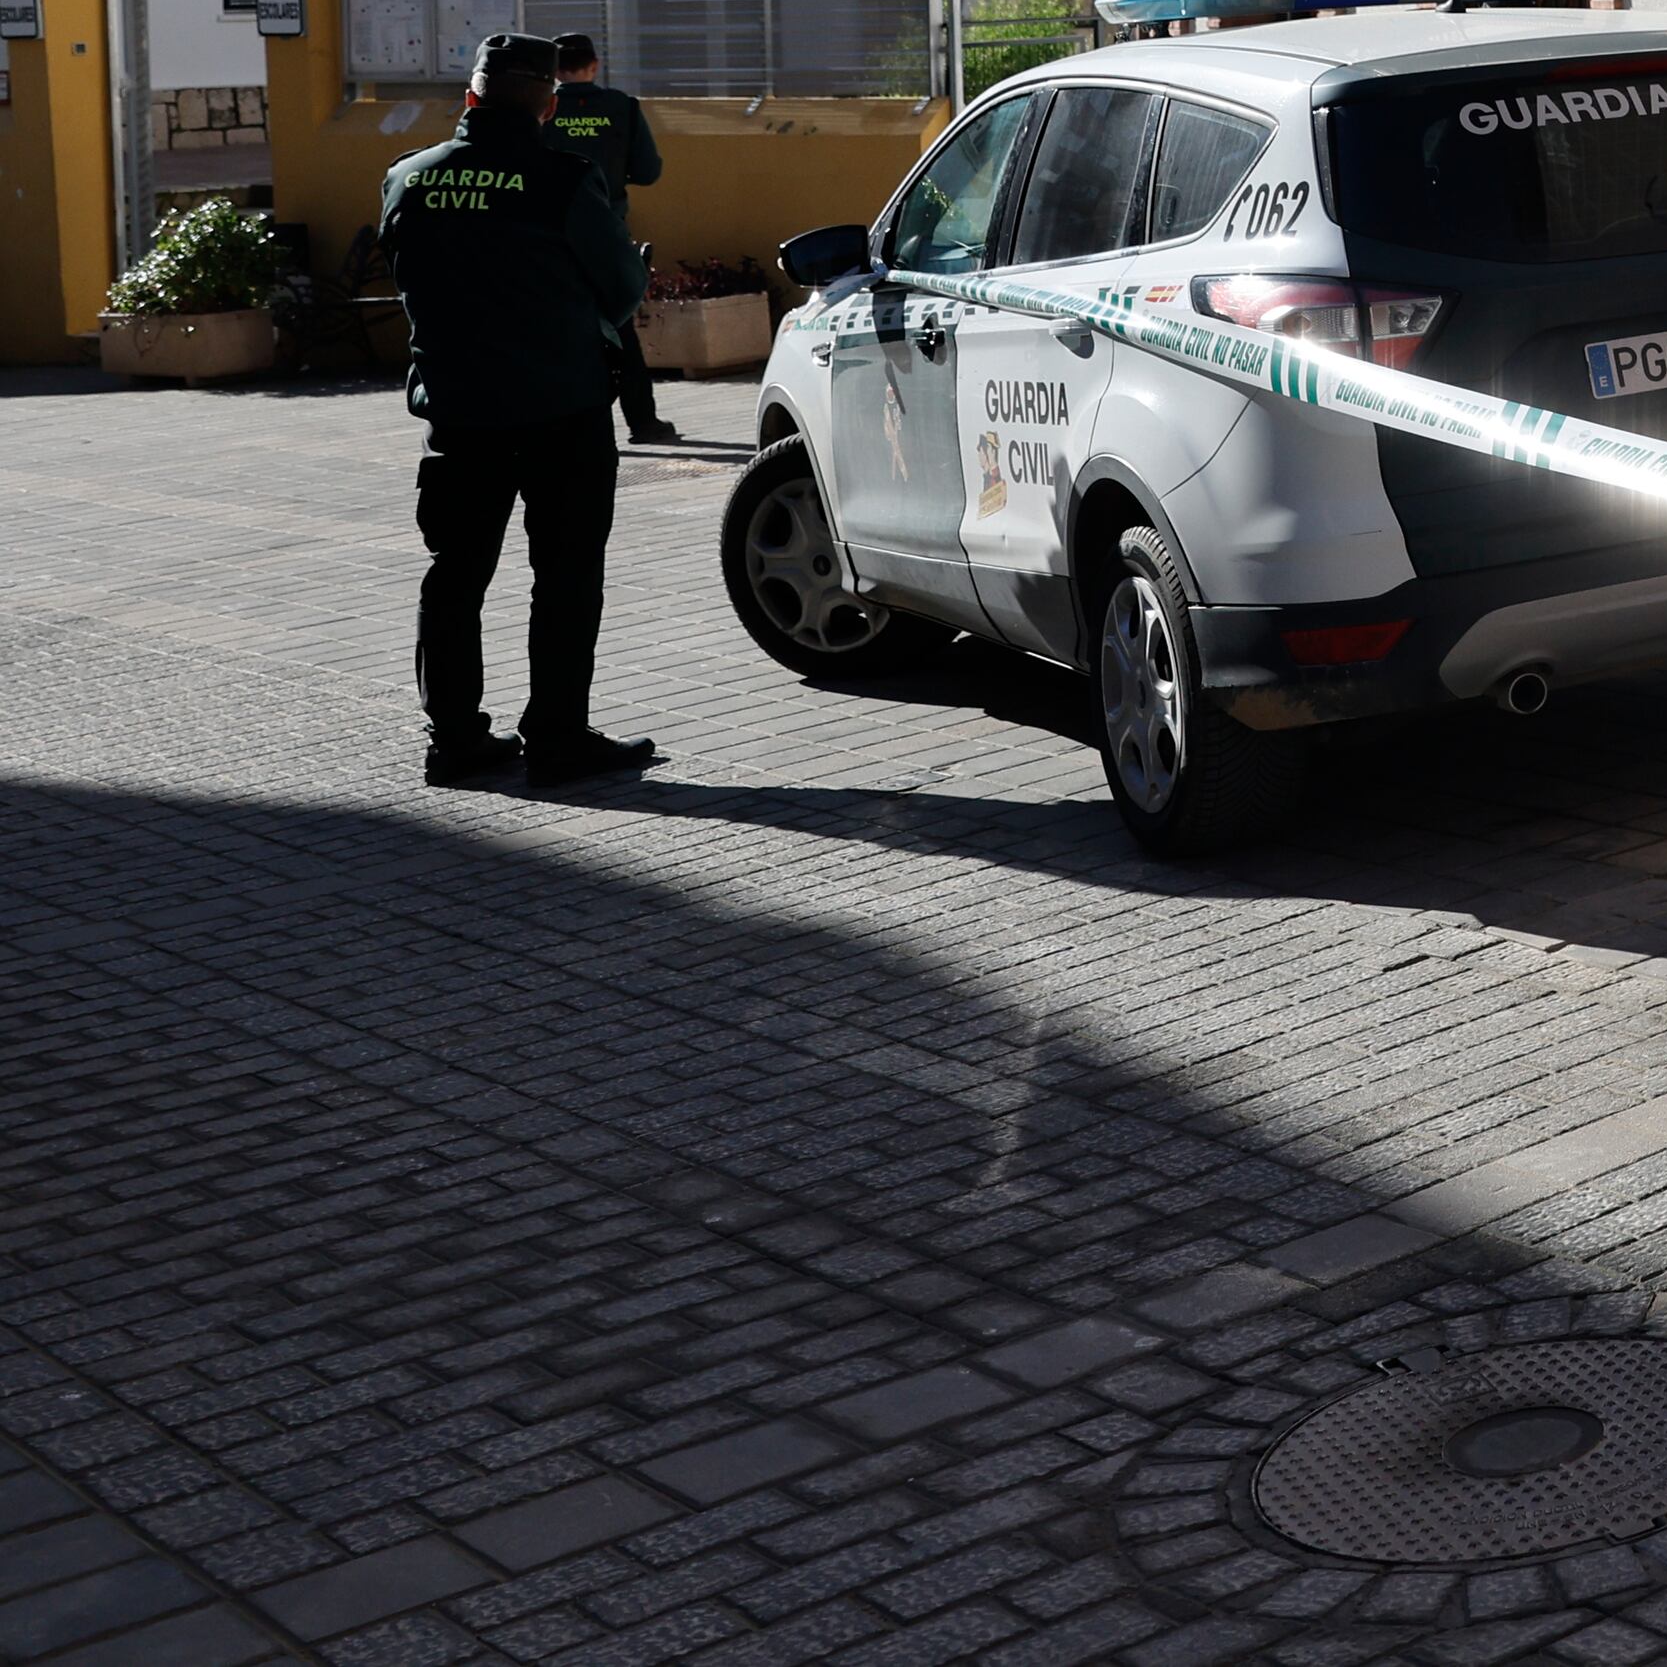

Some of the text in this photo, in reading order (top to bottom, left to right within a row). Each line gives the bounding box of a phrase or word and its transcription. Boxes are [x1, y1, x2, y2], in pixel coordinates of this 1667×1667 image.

[554, 117, 612, 127] GUARDIA
[567, 126, 599, 137] CIVIL
[404, 168, 525, 192] GUARDIA
[425, 191, 489, 210] CIVIL
[1245, 180, 1310, 241] 062
[1184, 326, 1215, 361] CIVIL
[1211, 334, 1230, 366] NO
[1228, 341, 1270, 377] PASAR
[1598, 375, 1609, 389] E
[984, 379, 1070, 427] GUARDIA
[1007, 440, 1054, 487] CIVIL
